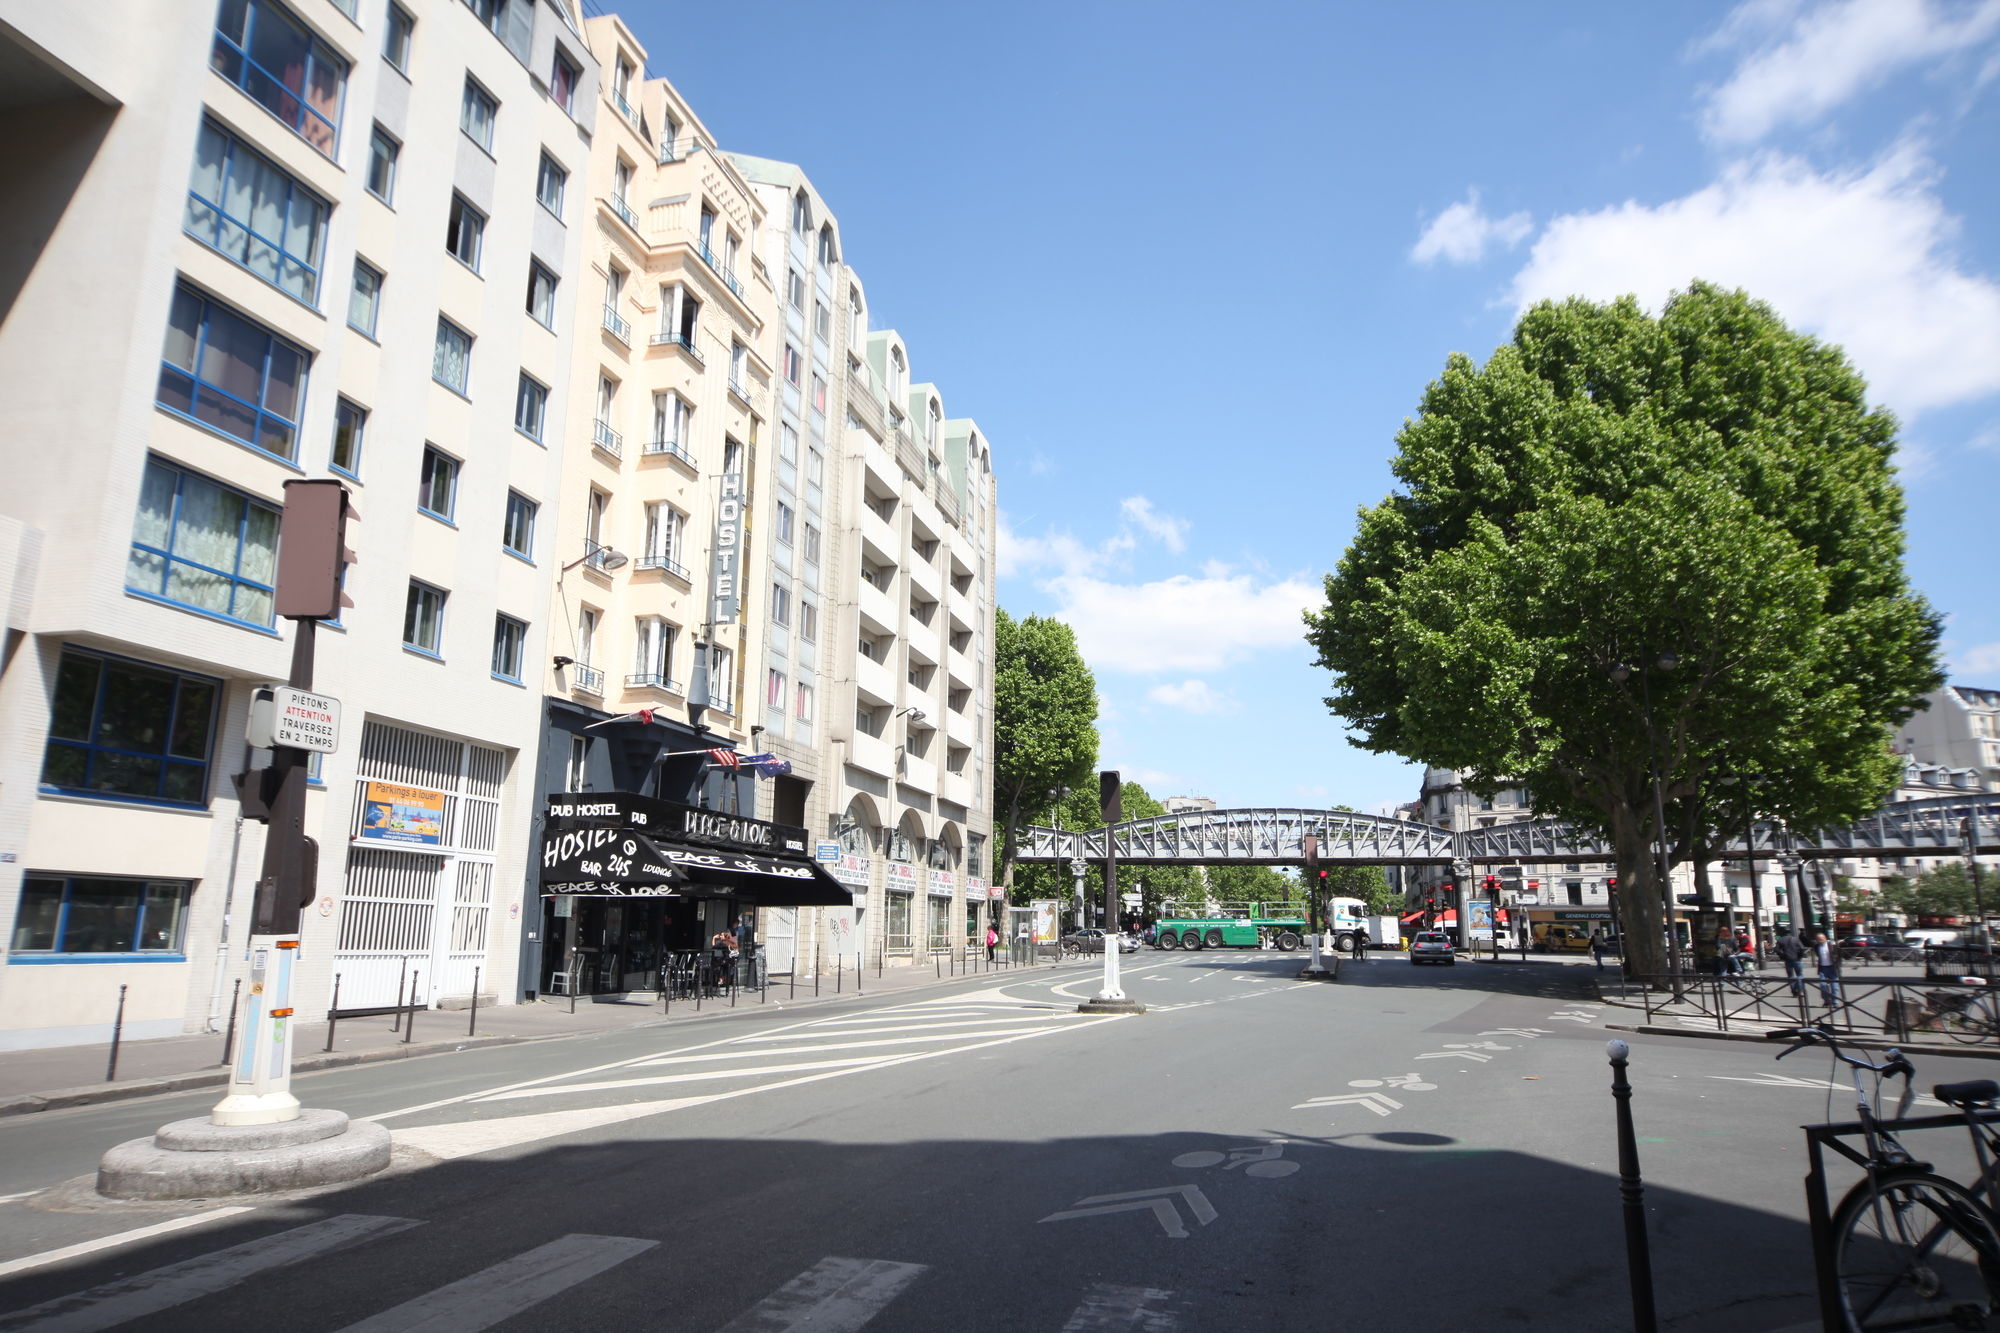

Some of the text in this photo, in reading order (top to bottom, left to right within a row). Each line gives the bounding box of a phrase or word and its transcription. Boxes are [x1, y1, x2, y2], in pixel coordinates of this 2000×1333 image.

[715, 474, 740, 622] HOSTEL
[292, 694, 328, 710] PIÉTONS
[286, 706, 332, 723] ATTENTION
[283, 718, 333, 736] TRAVERSEZ
[280, 730, 333, 748] EN 2 TEMPS
[376, 783, 438, 800] Parkings à louer
[551, 804, 620, 816] PUB HOSTEL
[631, 812, 647, 825] PUB
[685, 810, 727, 838] PEACE
[742, 821, 772, 846] LOVE
[544, 830, 618, 868] HOSTEL
[786, 840, 804, 851] HOSTEL
[580, 854, 632, 877] BAR 245
[642, 863, 673, 878] LOUNGE
[547, 881, 598, 894] PEACE
